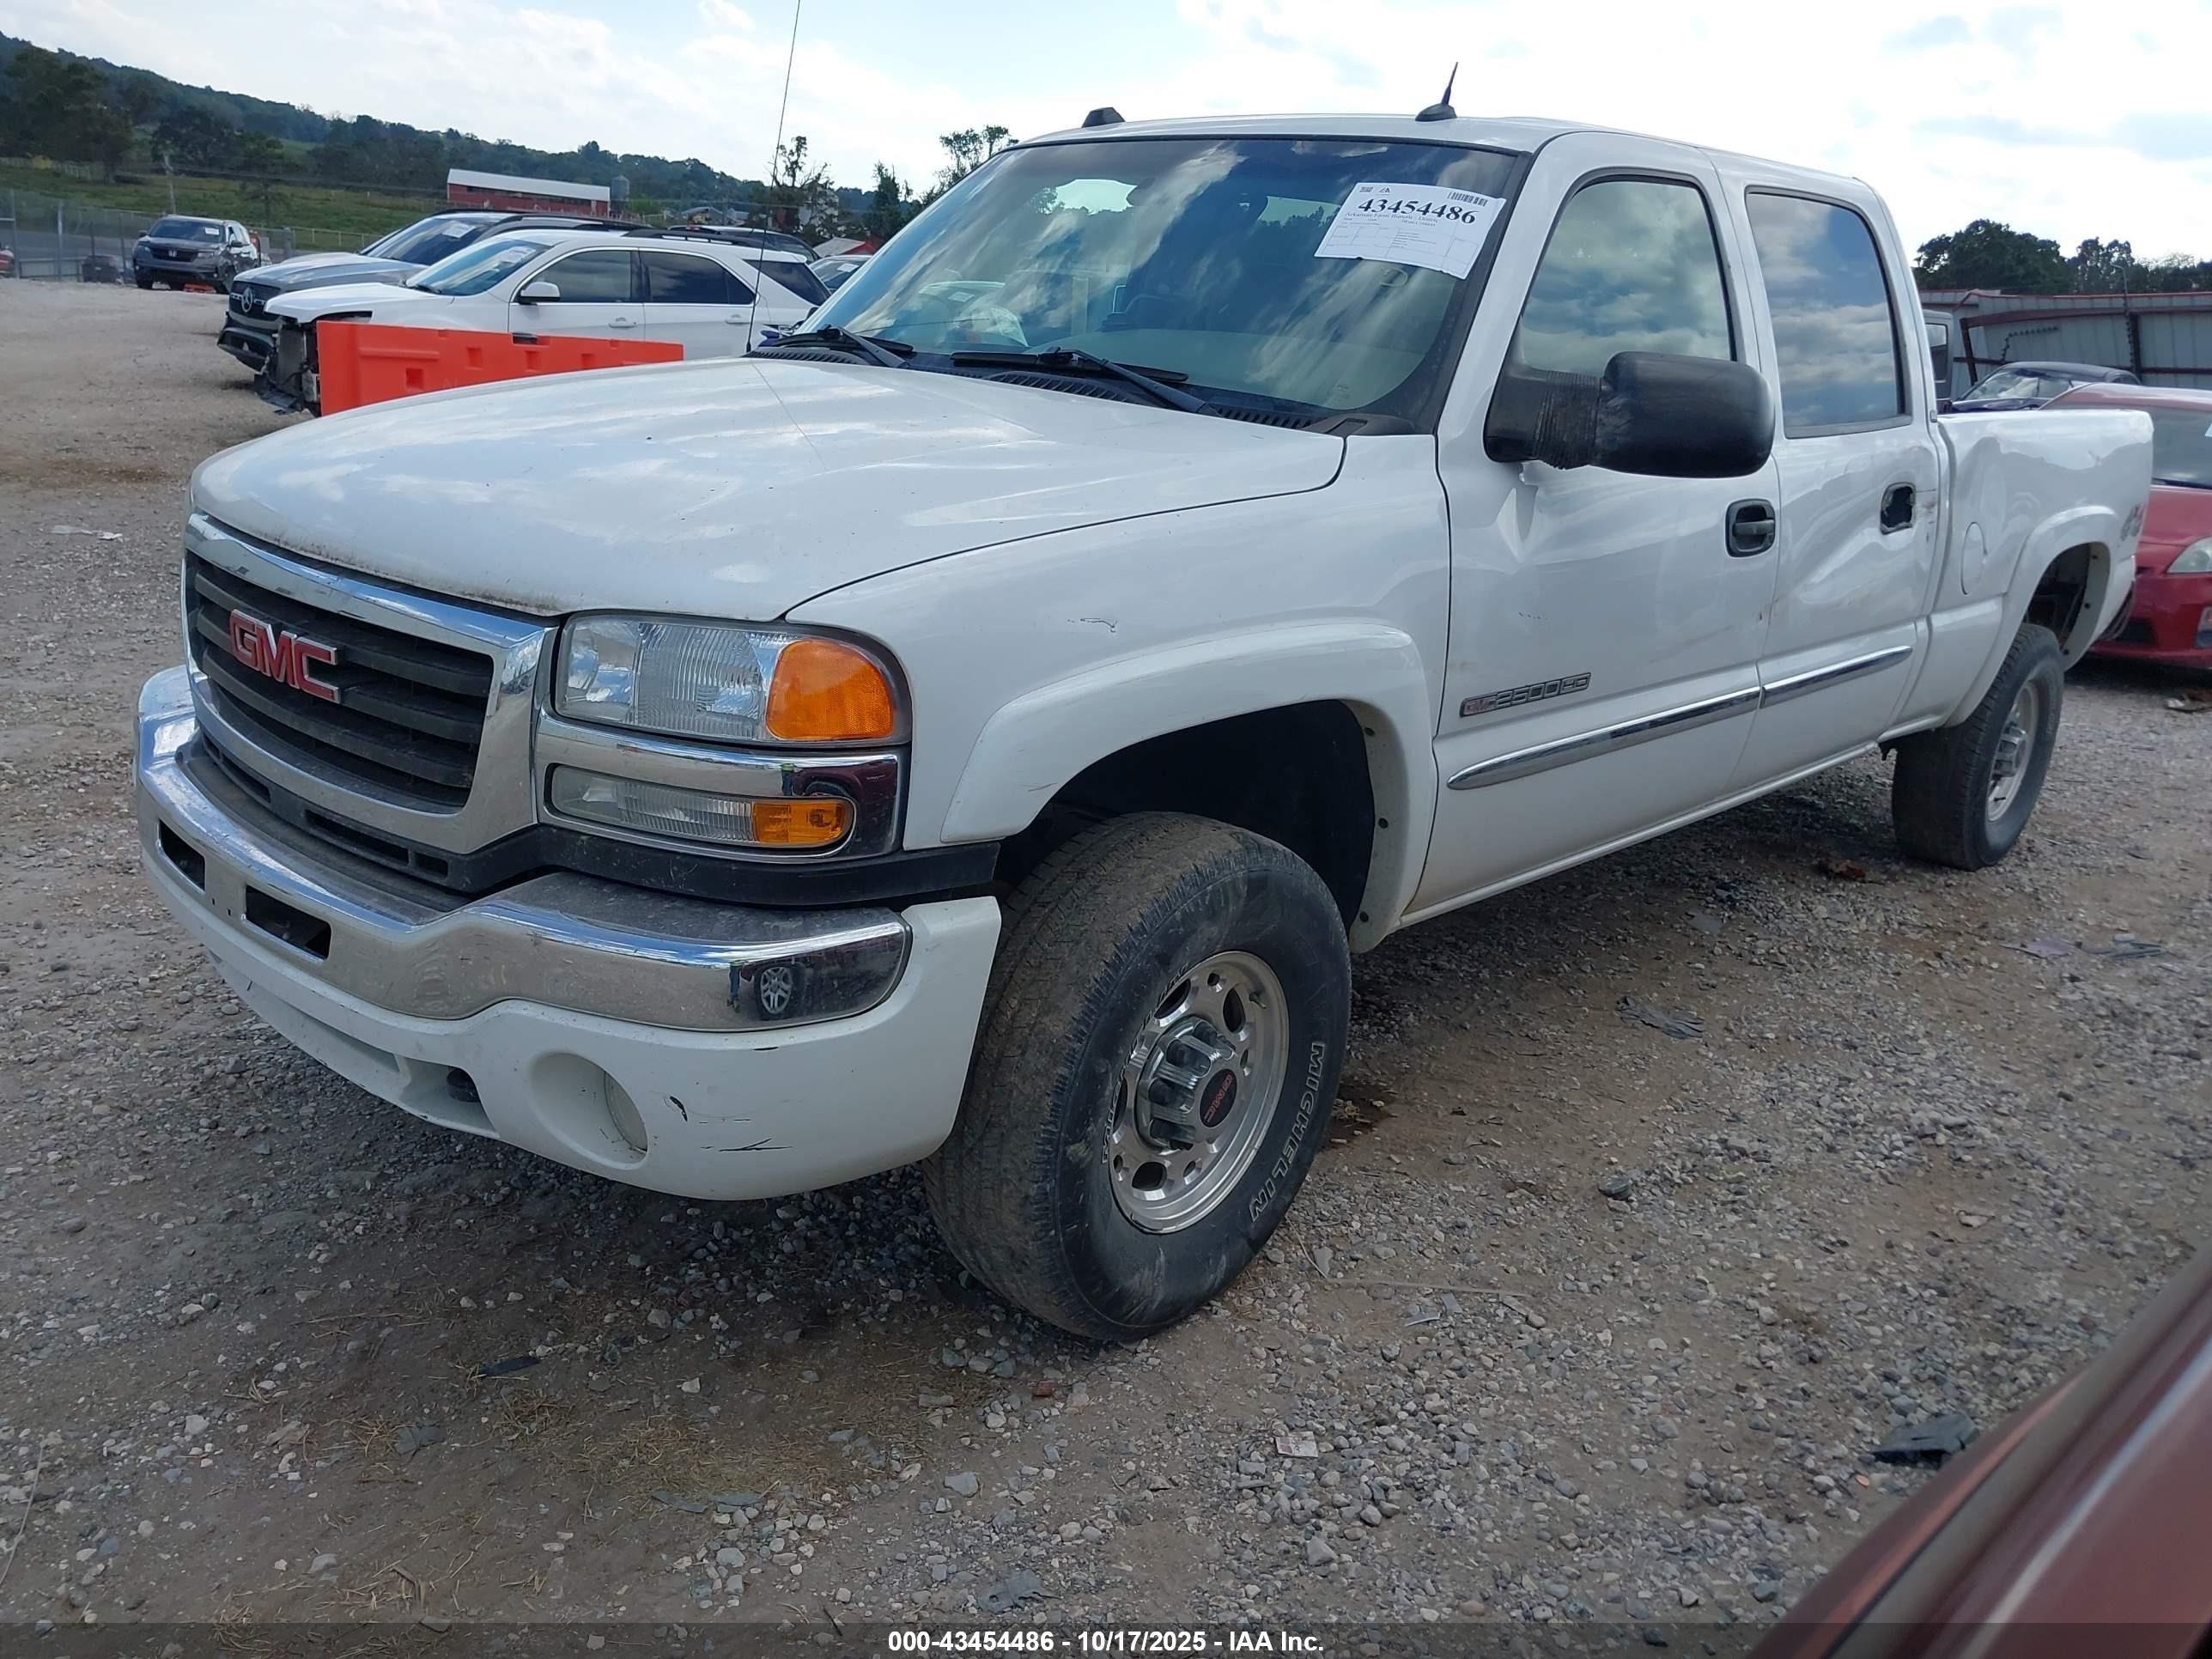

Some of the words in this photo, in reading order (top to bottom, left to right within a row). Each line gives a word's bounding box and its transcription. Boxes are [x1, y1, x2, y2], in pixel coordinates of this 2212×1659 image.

[1358, 198, 1479, 224] 43454486
[229, 609, 340, 703] GMC
[1204, 1073, 1233, 1123] GMC
[1248, 1042, 1326, 1223] MICHELIN
